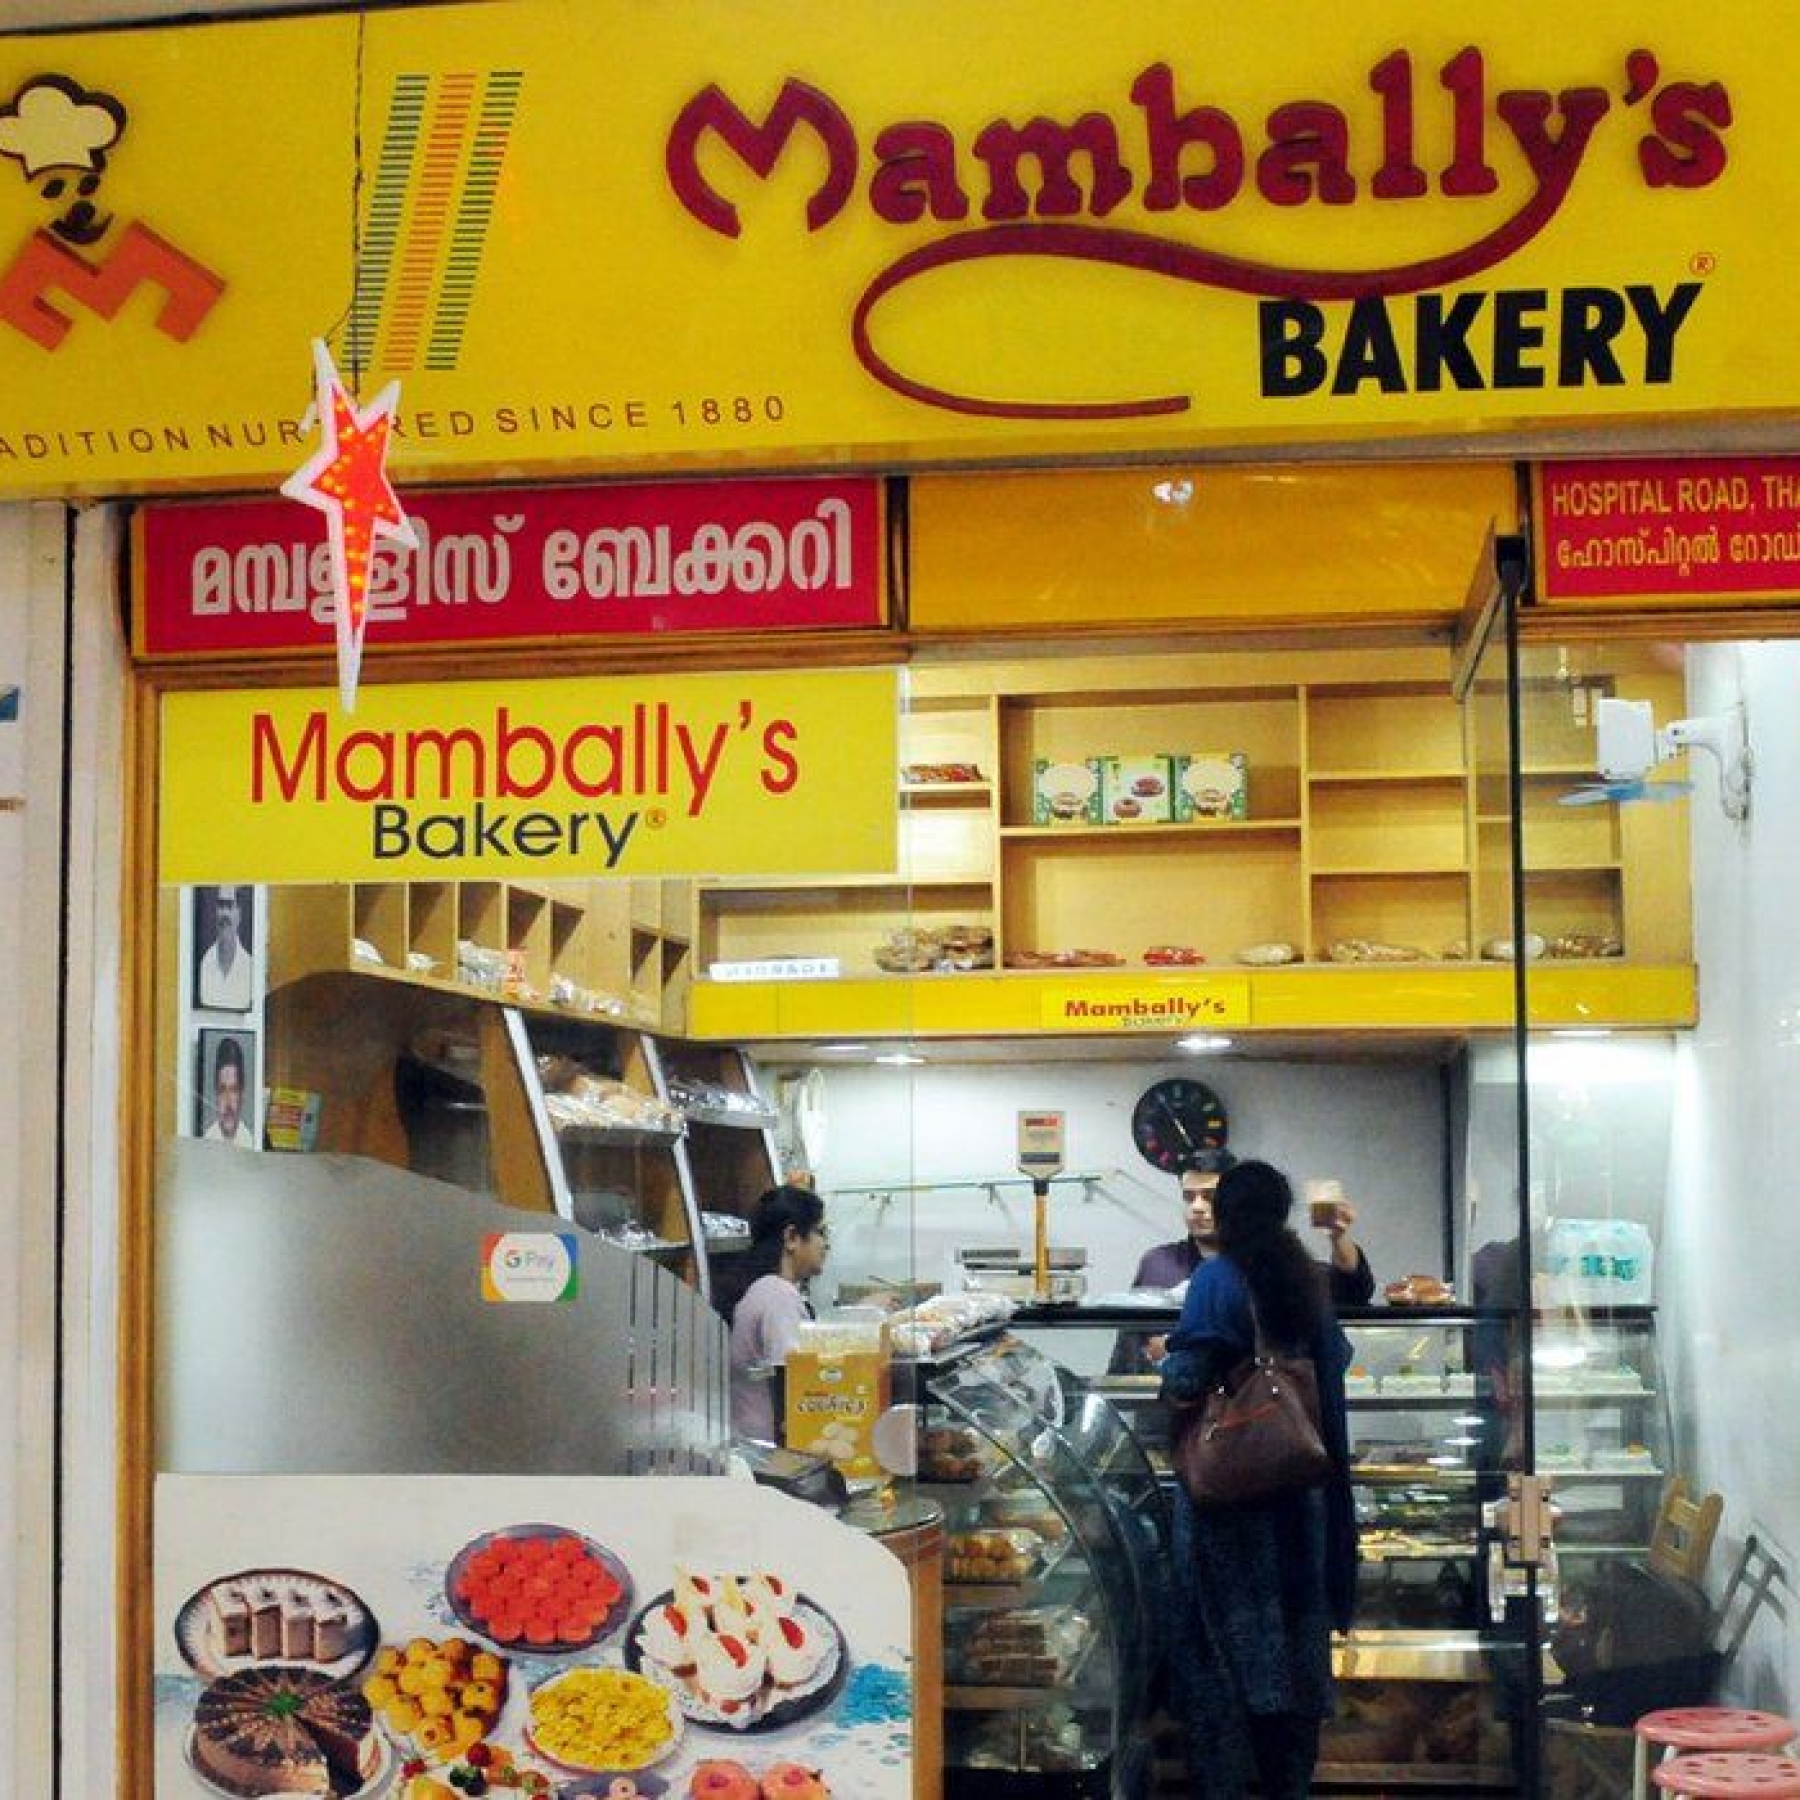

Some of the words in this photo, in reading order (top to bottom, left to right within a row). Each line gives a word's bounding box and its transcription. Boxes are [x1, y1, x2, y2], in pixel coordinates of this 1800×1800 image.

[665, 47, 1731, 302] Mambally's
[1258, 282, 1702, 399] BAKERY
[495, 401, 648, 435] SINCE
[673, 395, 784, 426] 1880
[1552, 480, 1672, 517] HOSPITAL
[542, 498, 852, 600] ബേക്കറി
[251, 700, 799, 818] Mambally's
[373, 803, 639, 868] Bakery
[1064, 997, 1226, 1019] Mambally's
